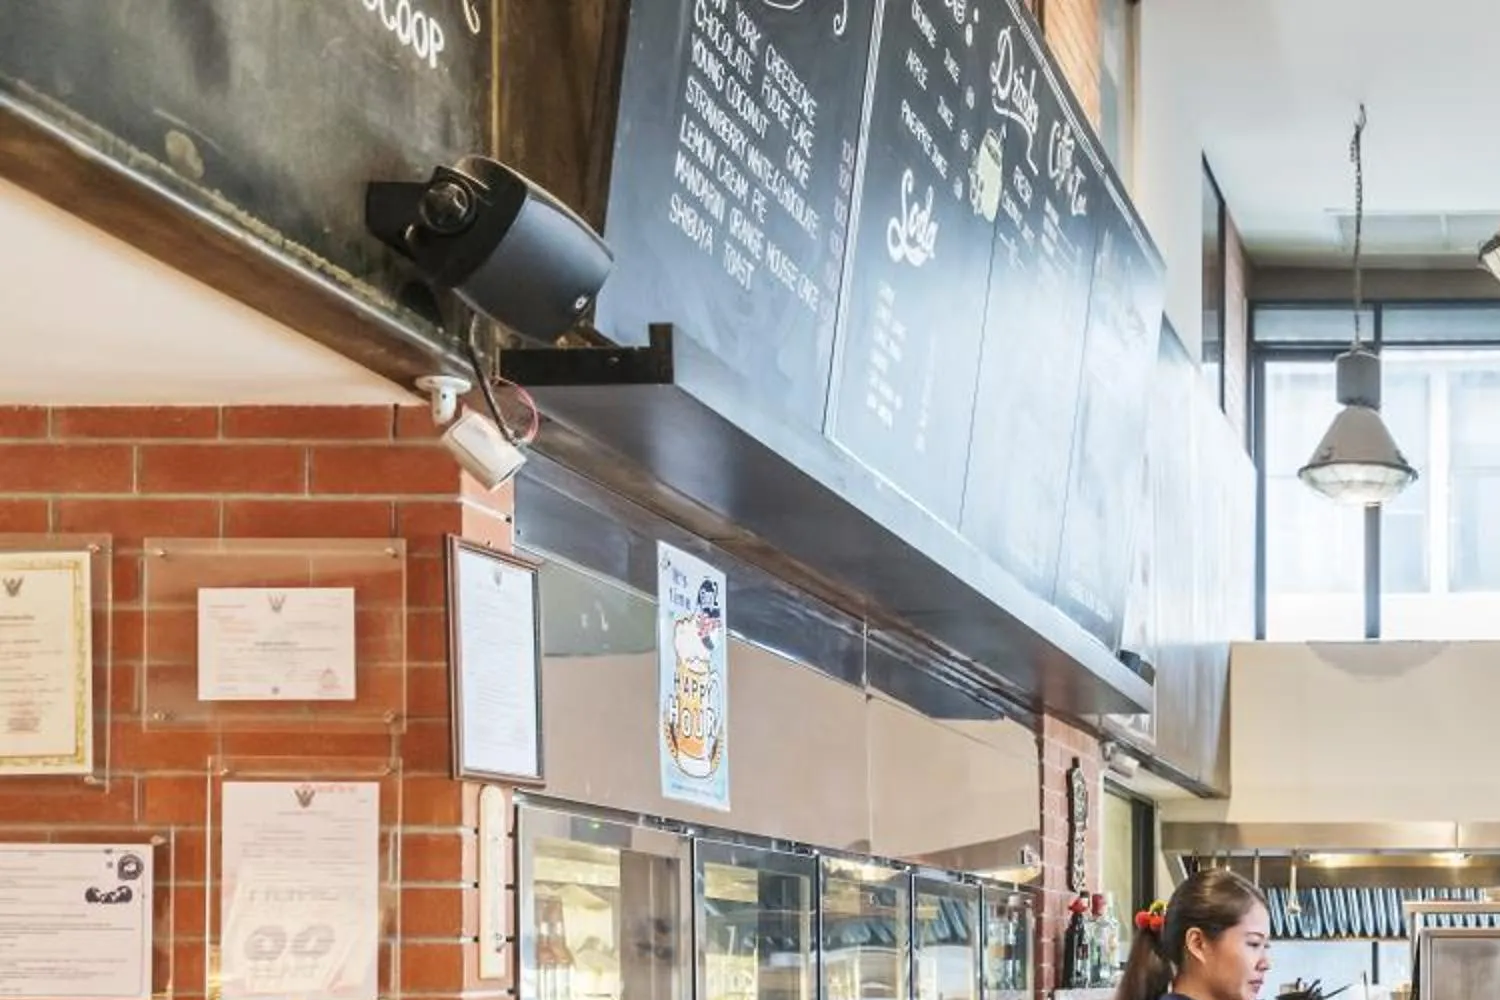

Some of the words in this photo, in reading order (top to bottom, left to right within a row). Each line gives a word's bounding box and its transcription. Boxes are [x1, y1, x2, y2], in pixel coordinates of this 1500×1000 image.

[362, 0, 445, 69] COOP
[691, 32, 725, 91] YOUNG
[726, 75, 770, 139] COCONUT
[680, 113, 718, 170] LEMON
[717, 153, 749, 206] CREAM
[667, 693, 718, 740] HOUR
[674, 671, 713, 707] HAPPY
